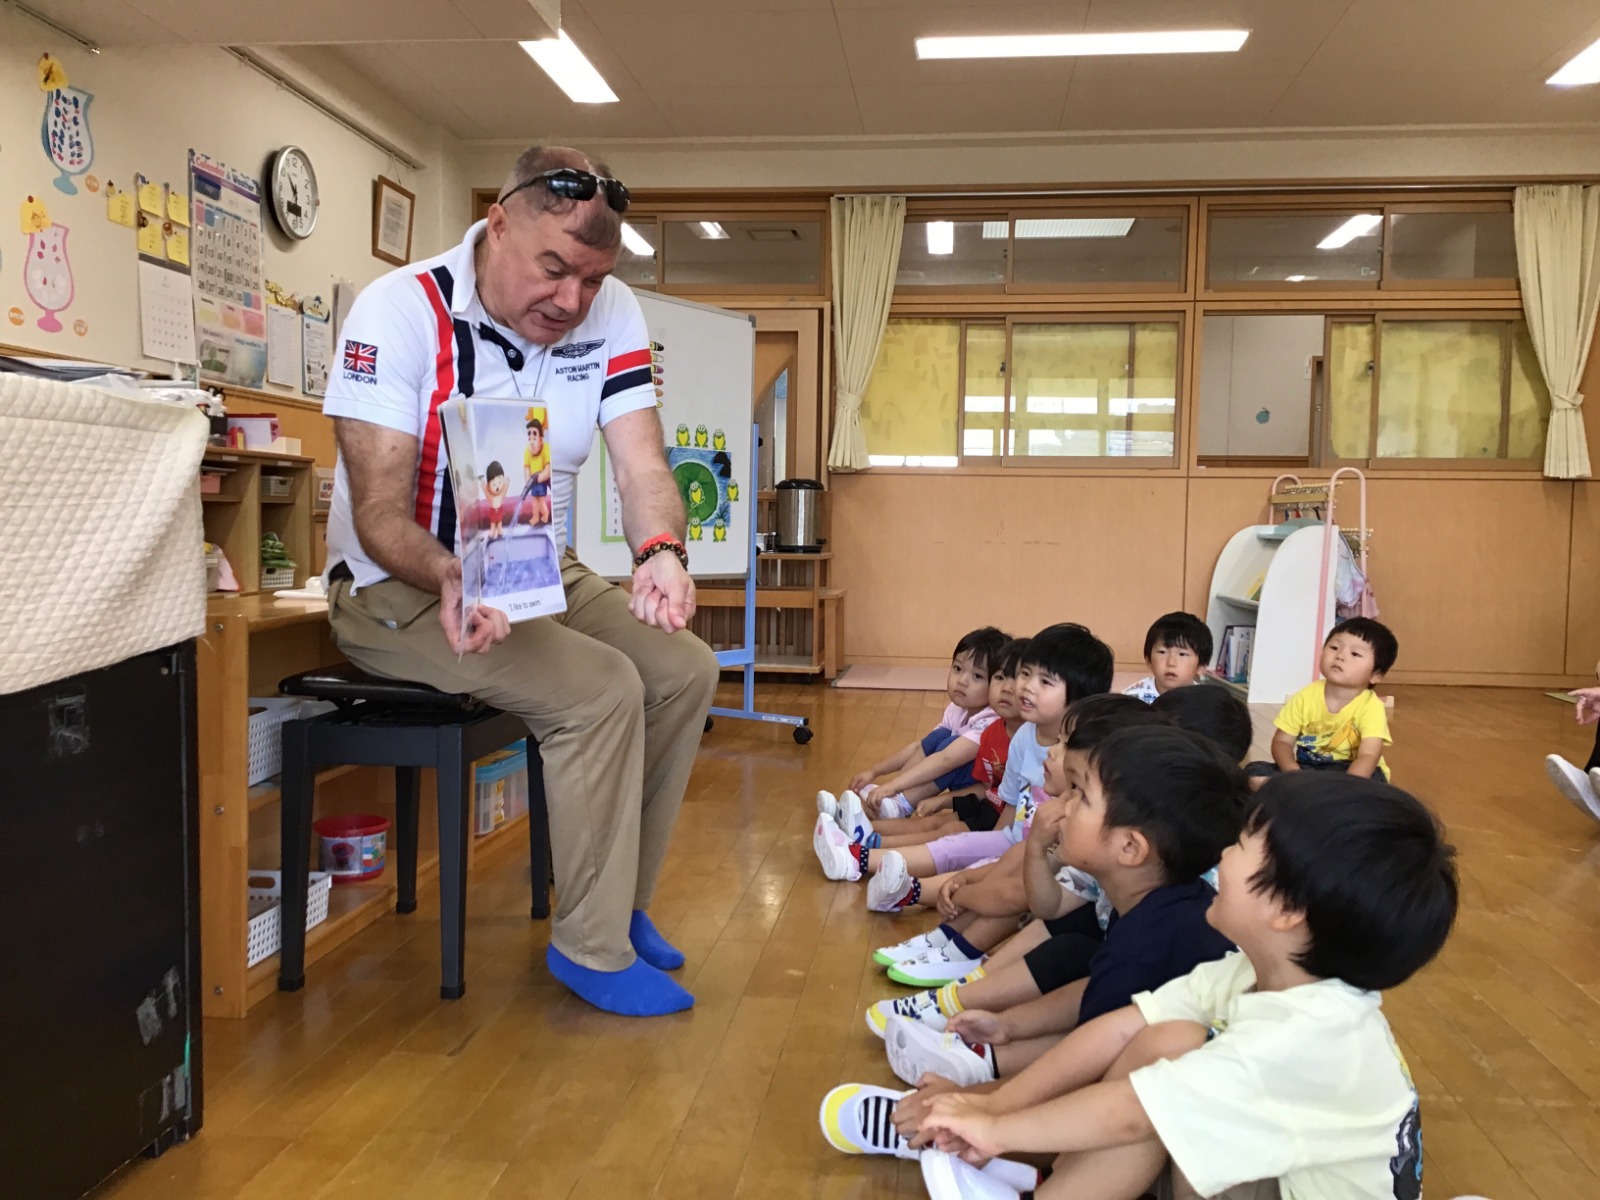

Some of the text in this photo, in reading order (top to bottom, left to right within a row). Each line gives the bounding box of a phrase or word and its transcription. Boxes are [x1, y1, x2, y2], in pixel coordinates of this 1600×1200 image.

[291, 157, 298, 168] 12
[304, 179, 309, 189] 2
[306, 195, 310, 205] 3
[198, 245, 204, 254] 12
[555, 361, 600, 375] ASTON MARTIN
[343, 371, 378, 385] LONDON
[567, 373, 590, 382] RACING
